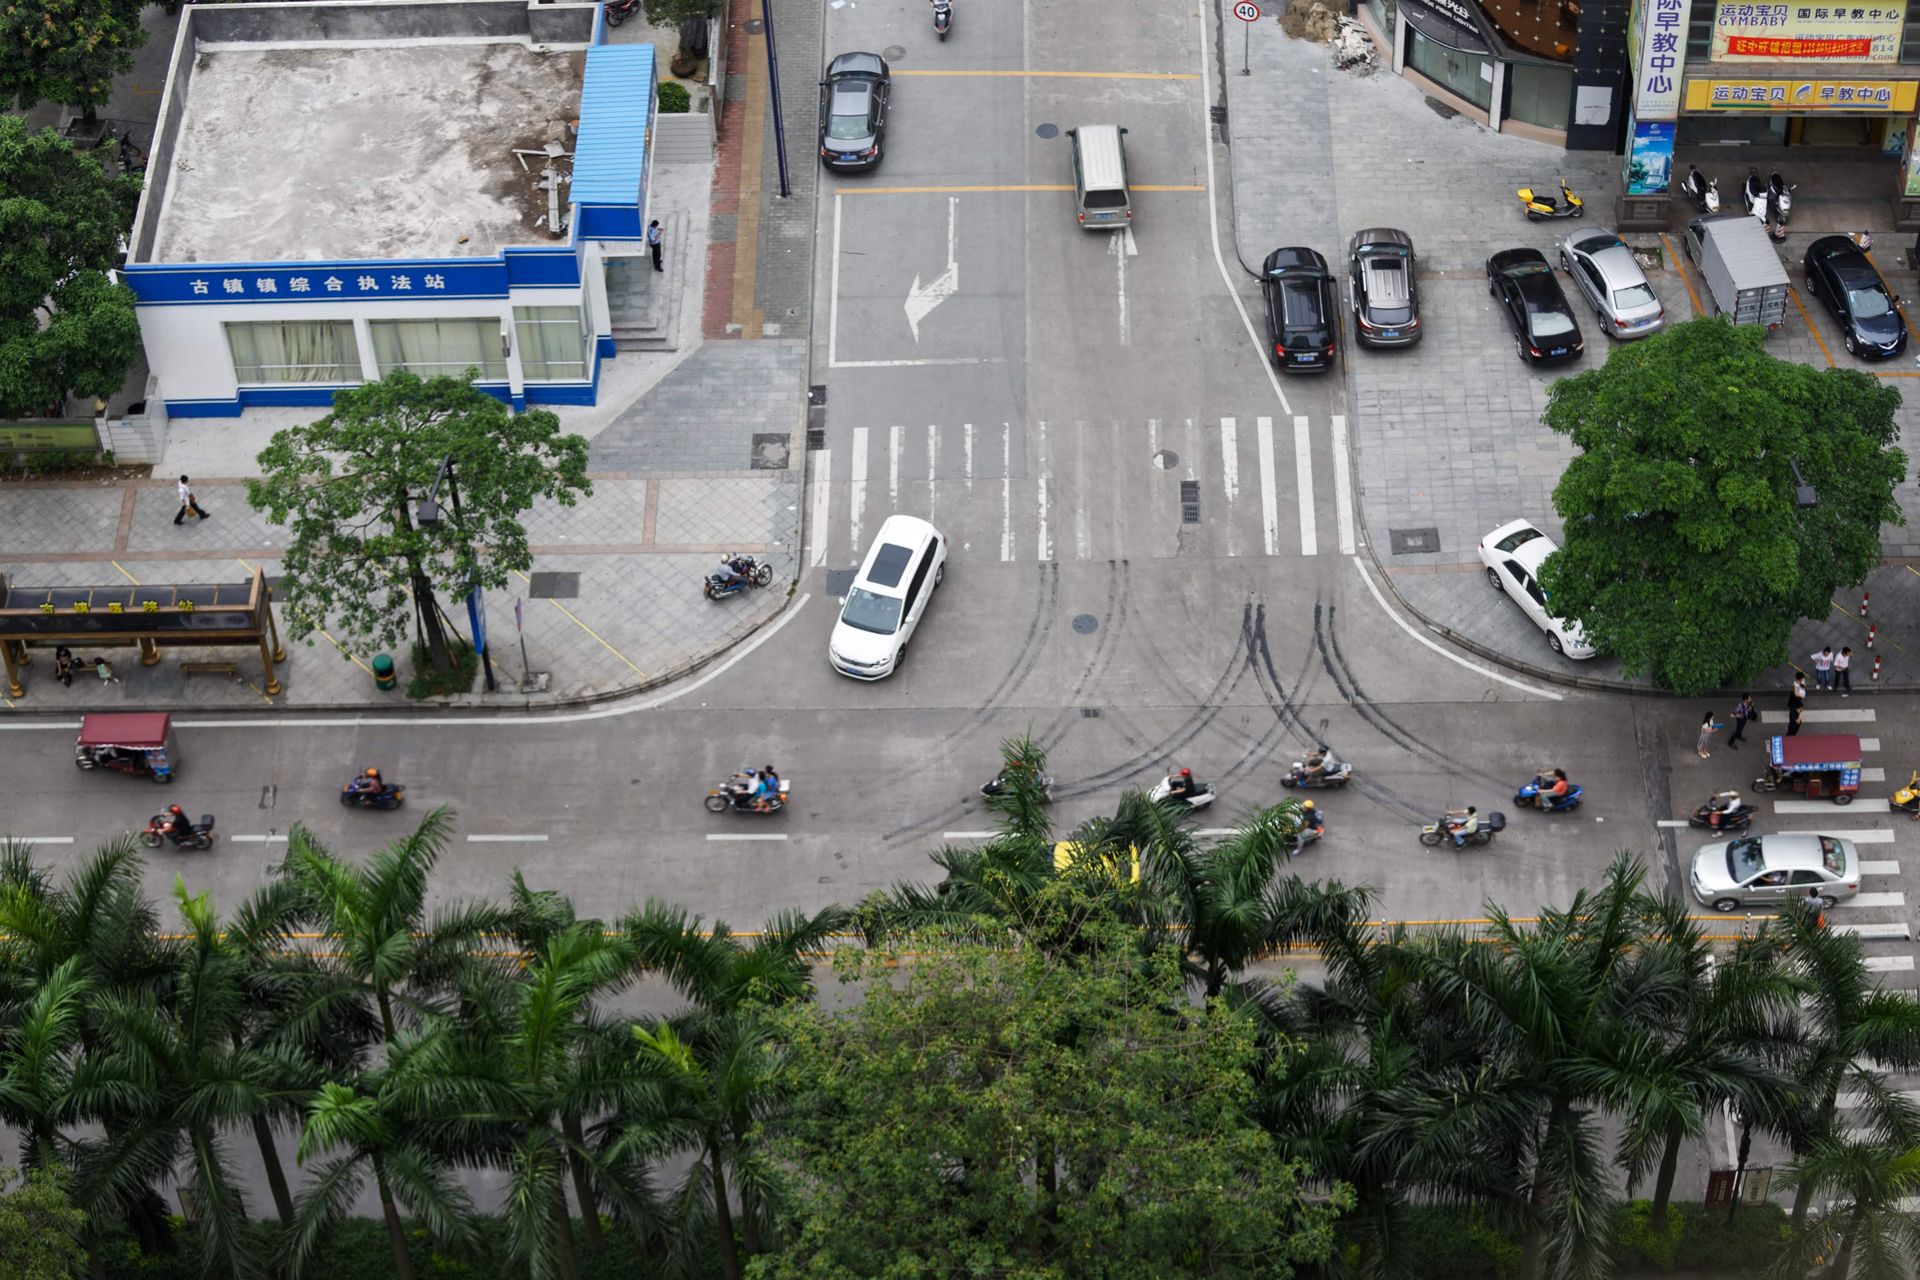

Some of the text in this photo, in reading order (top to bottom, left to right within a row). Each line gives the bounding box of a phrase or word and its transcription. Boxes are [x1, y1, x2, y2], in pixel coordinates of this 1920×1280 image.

[1239, 6, 1255, 18] 40
[1720, 4, 1788, 16] 运动宝贝
[1797, 8, 1900, 20] 国际早教中心
[1718, 16, 1788, 26] GYMBABY
[1712, 86, 1785, 101] 运动宝贝
[1819, 86, 1891, 101] 早教中心
[190, 274, 445, 294] 古镇镇综合执法站
